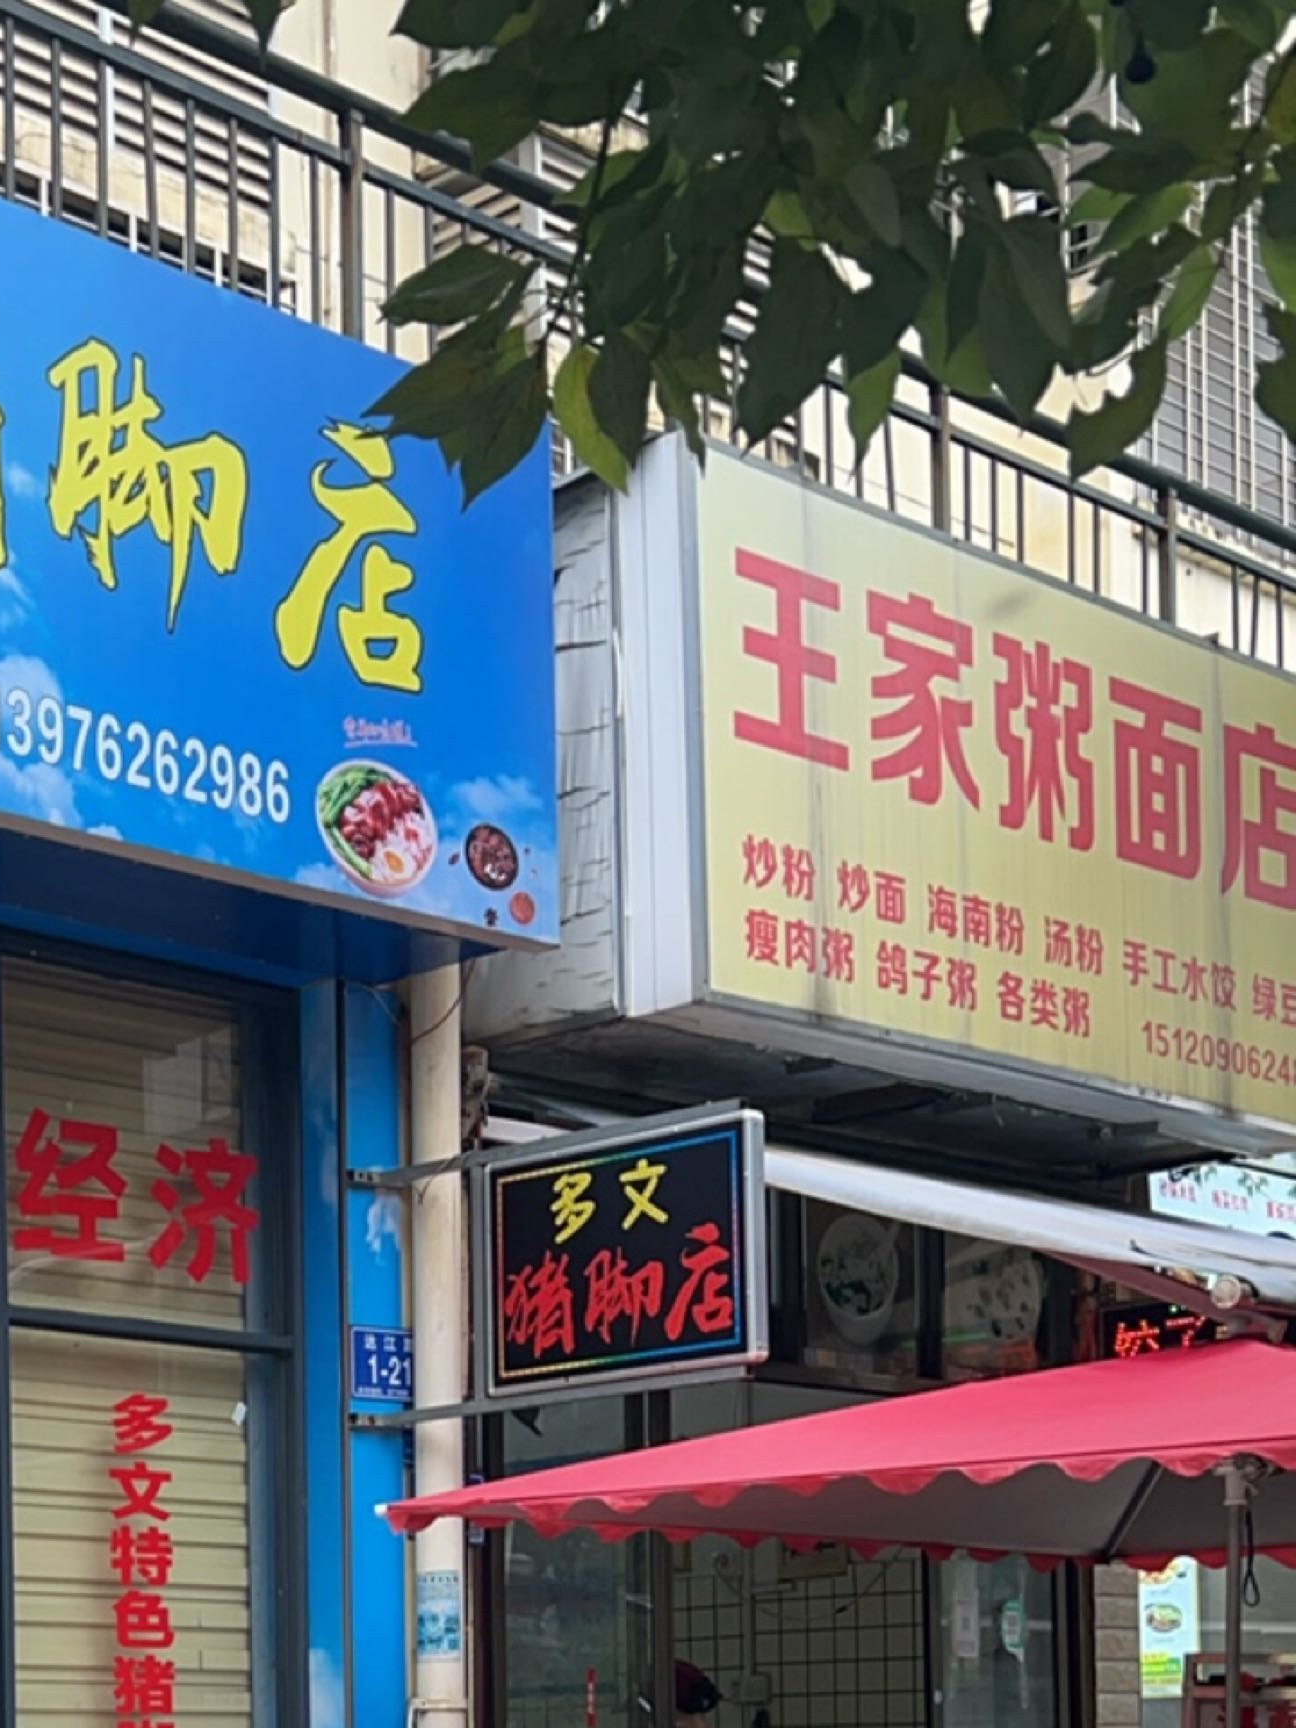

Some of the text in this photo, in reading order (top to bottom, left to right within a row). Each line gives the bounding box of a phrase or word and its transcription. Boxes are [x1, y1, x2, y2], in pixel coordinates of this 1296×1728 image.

[733, 546, 1296, 911] 王家粥面店
[742, 833, 816, 902] 炒粉
[837, 860, 906, 926] 炒面
[927, 884, 1025, 955] 海南粉
[1044, 915, 1102, 975] 汤粉
[1122, 941, 1237, 1012] 手工水饺
[744, 908, 1090, 1039] 瘦肉粥 鸽子粥 各类粥
[1142, 1019, 1296, 1088] 1512090624
[550, 1159, 668, 1243] 多文
[504, 1223, 734, 1359] 猪脚店
